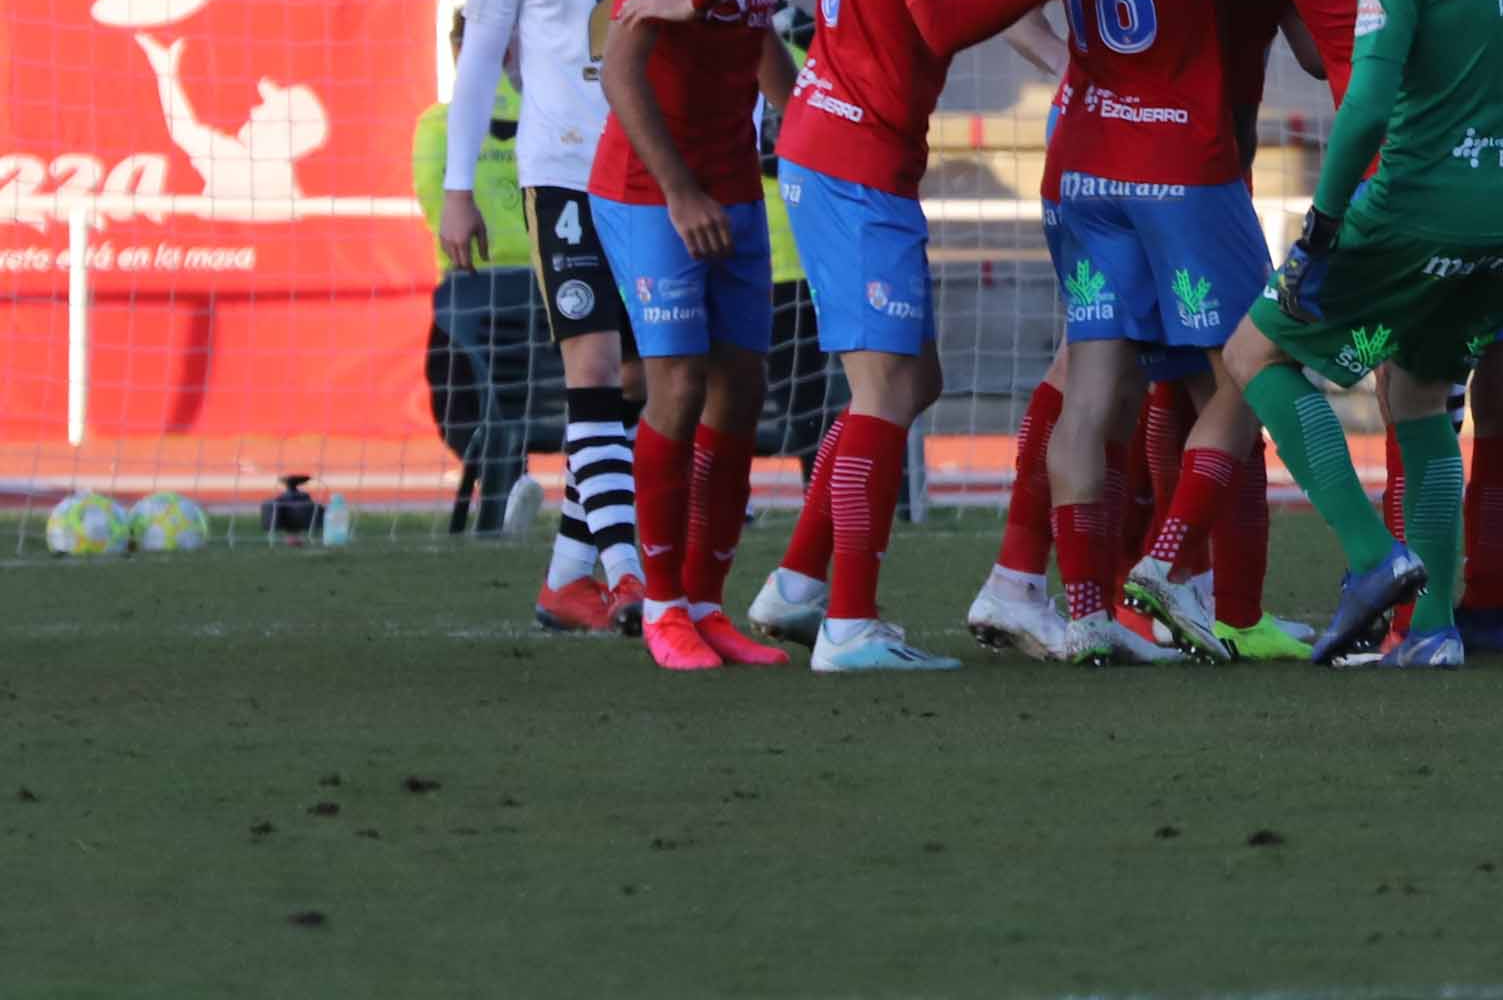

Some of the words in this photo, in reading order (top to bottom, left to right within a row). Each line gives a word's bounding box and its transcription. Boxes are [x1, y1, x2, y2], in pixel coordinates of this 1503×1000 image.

[1101, 99, 1188, 124] EZQUERRO
[554, 199, 583, 245] 4
[117, 247, 150, 272] en
[154, 242, 180, 271] la
